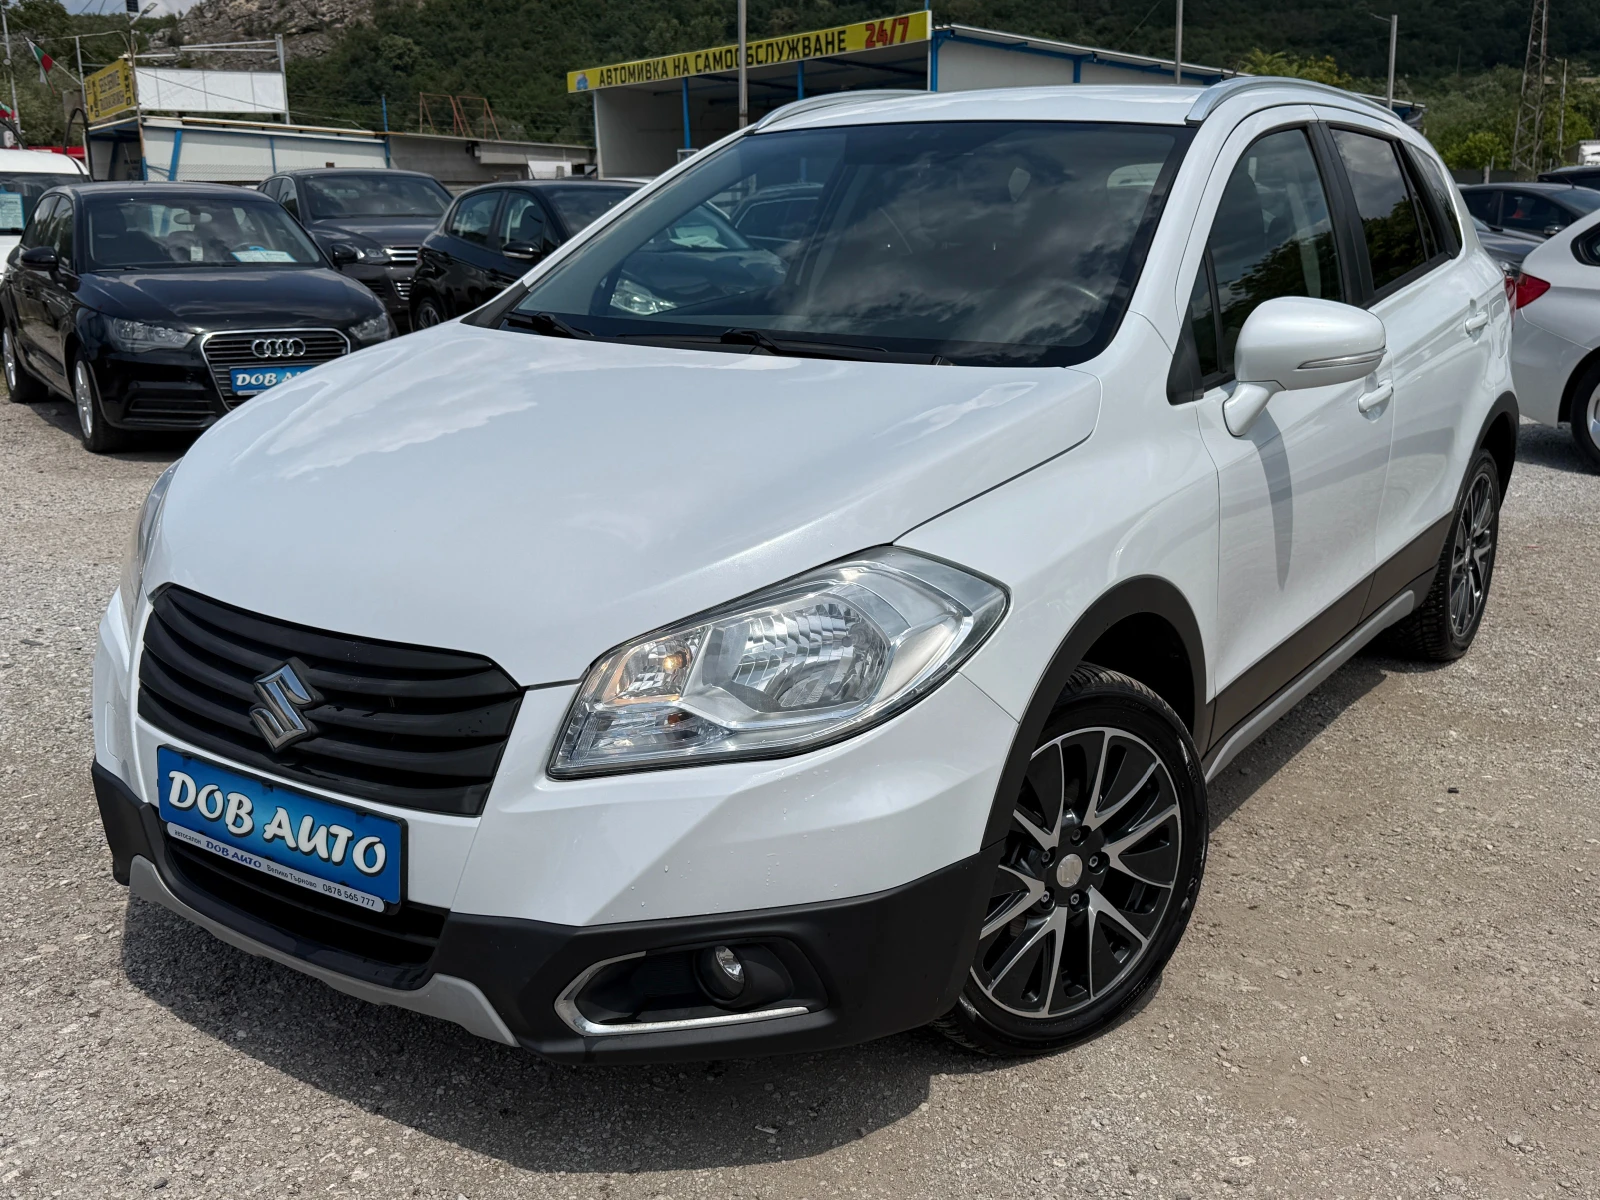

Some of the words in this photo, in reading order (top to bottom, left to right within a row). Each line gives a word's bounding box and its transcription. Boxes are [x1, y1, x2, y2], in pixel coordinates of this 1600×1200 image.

[600, 60, 669, 87] АВТОМИВКА
[673, 56, 691, 78] НА
[865, 17, 909, 49] 24/7
[236, 373, 277, 386] DOB
[168, 770, 254, 836] DOB
[263, 806, 387, 875] AUTO
[205, 840, 230, 857] DOB
[231, 851, 262, 869] AUTO
[266, 864, 289, 879] Велико
[322, 883, 342, 897] 0878
[344, 890, 359, 902] 565
[360, 895, 375, 907] 777
